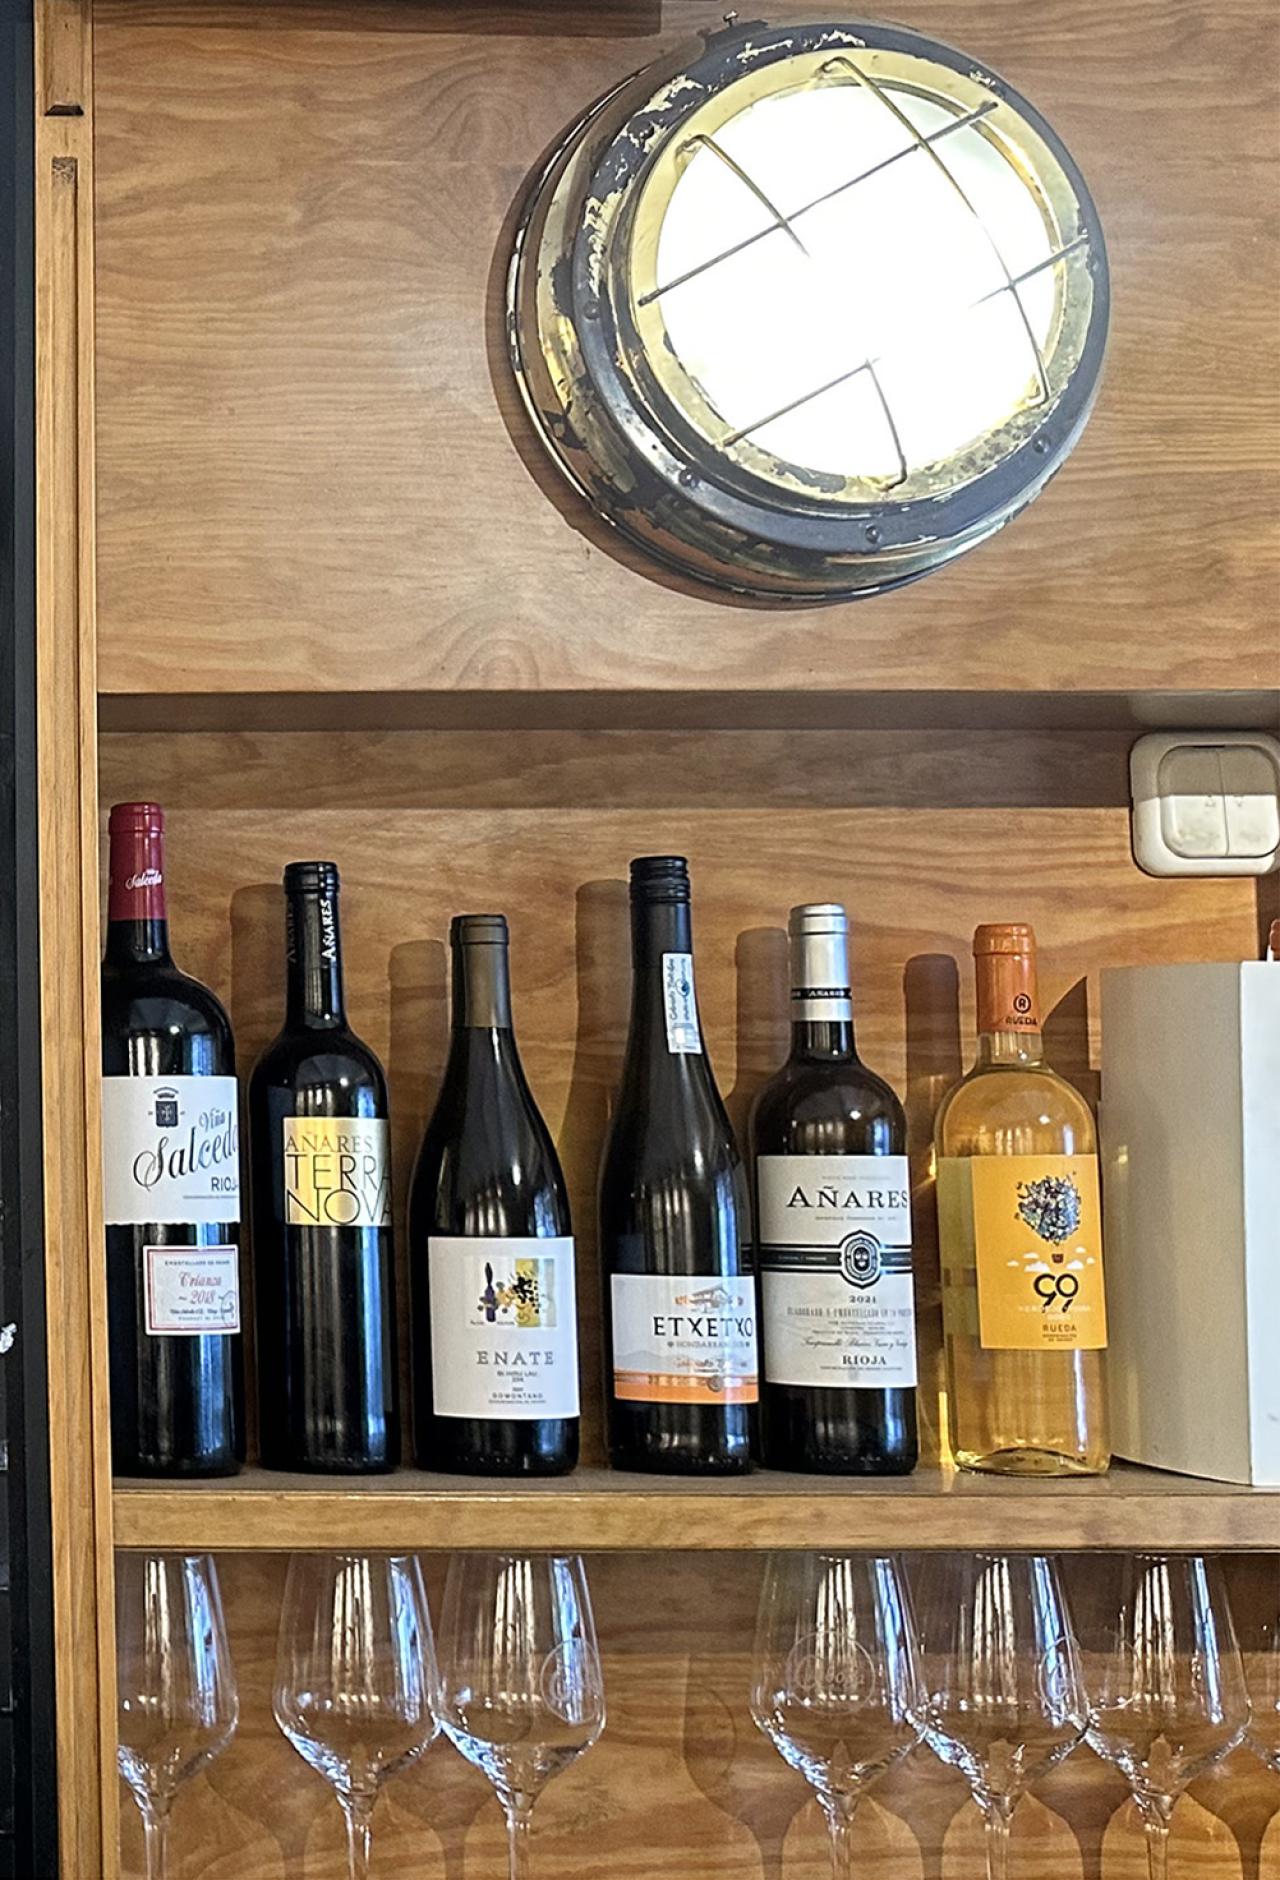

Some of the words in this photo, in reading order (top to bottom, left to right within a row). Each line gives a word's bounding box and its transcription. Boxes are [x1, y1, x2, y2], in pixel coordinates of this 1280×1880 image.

[320, 898, 337, 962] AÑARES
[285, 1132, 373, 1153] AÑARES
[786, 1185, 908, 1208] AÑARES
[476, 1351, 554, 1365] ENATE
[842, 1355, 887, 1365] RIOJA
